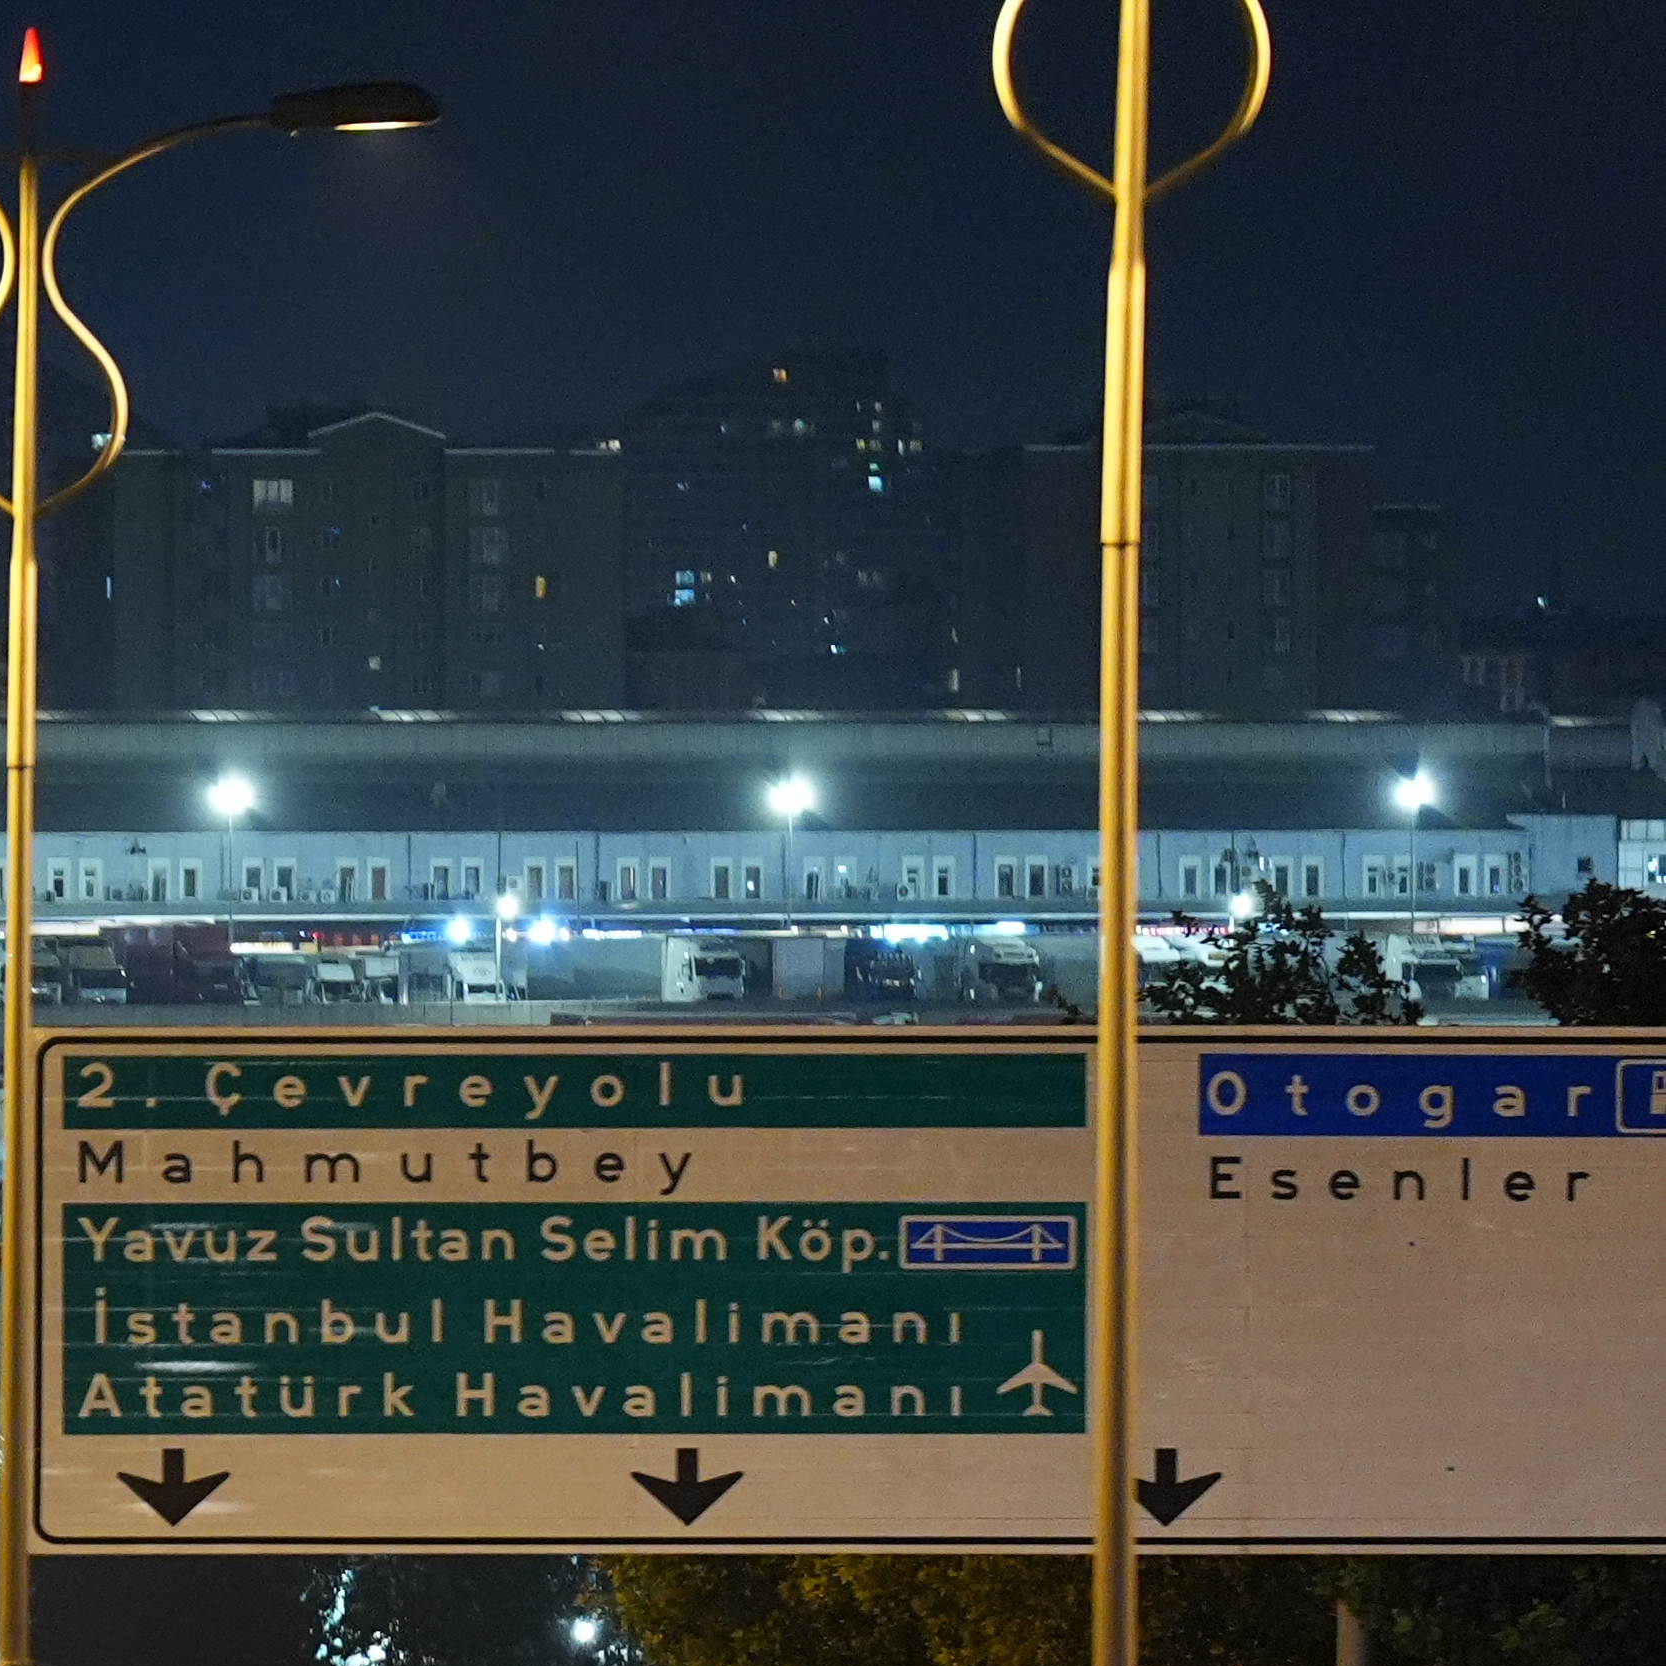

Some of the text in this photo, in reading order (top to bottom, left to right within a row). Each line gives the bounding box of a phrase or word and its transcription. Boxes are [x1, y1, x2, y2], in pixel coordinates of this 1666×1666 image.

[77, 1061, 745, 1121] 2. Çevreyolu
[1206, 1070, 1592, 1129] Otogar
[78, 1140, 693, 1195] Mahmutbey
[1210, 1155, 1591, 1200] Esenler
[77, 1216, 889, 1272] Yavuz Sultan Selim Köp.
[93, 1287, 962, 1345] İstanbul Havalimanı
[77, 1372, 963, 1419] Atatürk Havalimanı
